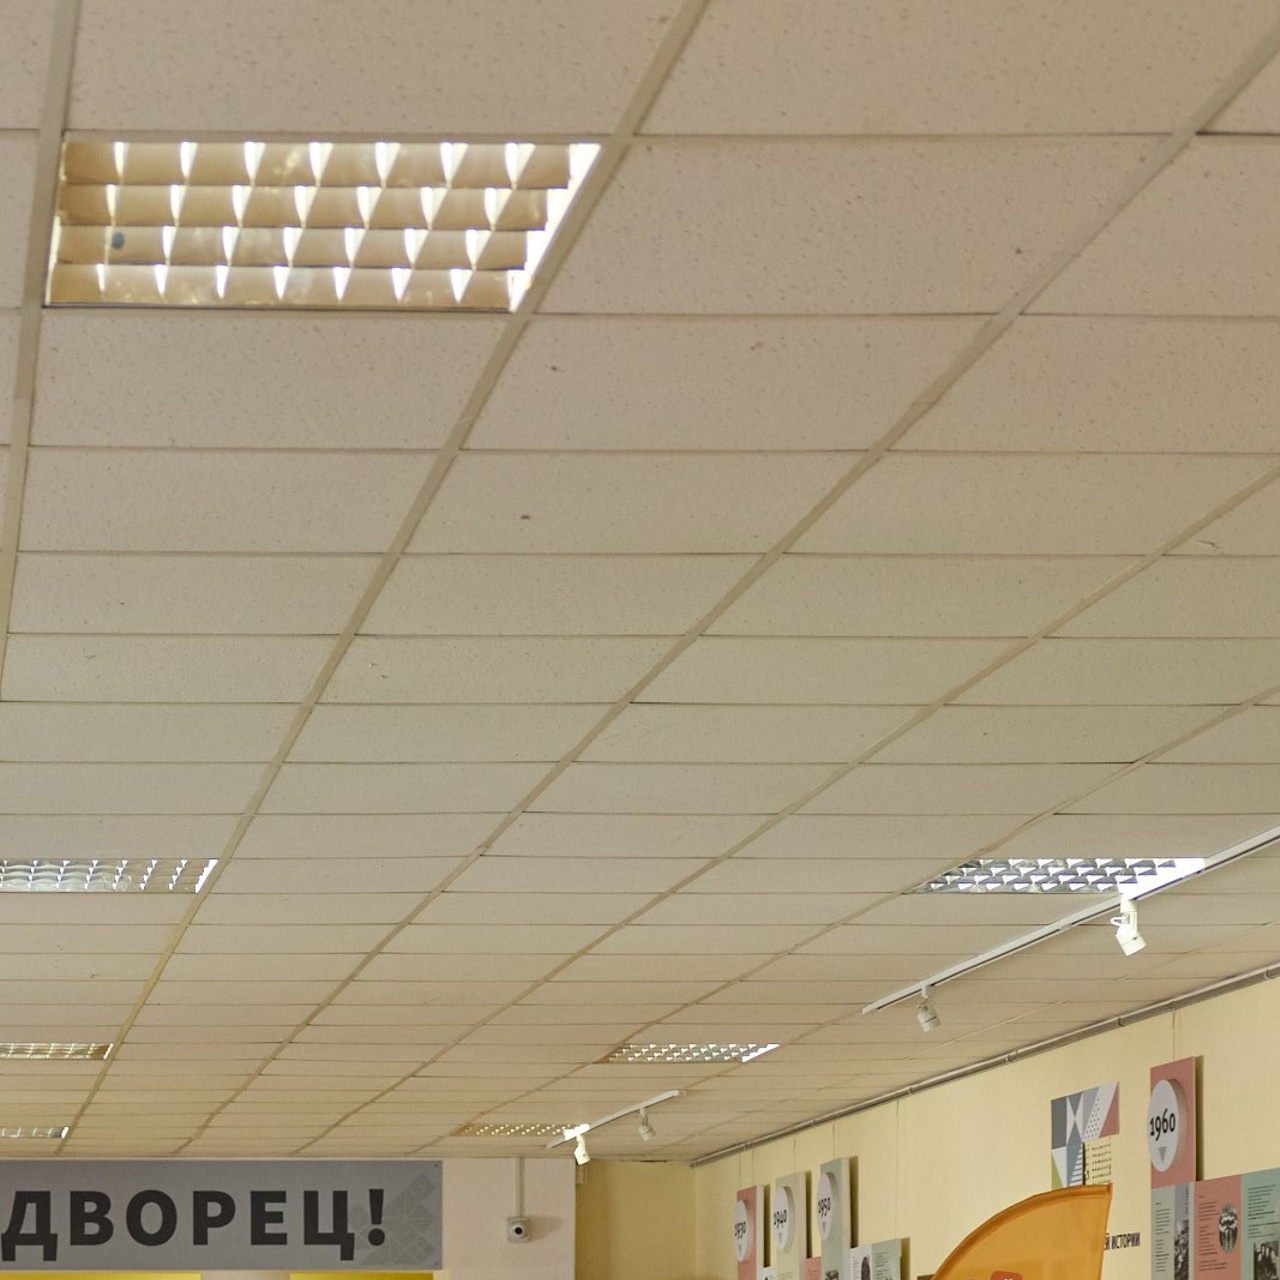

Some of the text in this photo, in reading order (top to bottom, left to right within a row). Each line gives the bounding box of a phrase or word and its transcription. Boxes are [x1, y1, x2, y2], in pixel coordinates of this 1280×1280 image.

[1150, 1108, 1176, 1141] 1960
[0, 1188, 386, 1262] ДВОРЕЦ!
[773, 1209, 787, 1228] 1940
[1111, 1232, 1141, 1250] ИСТОРИИ
